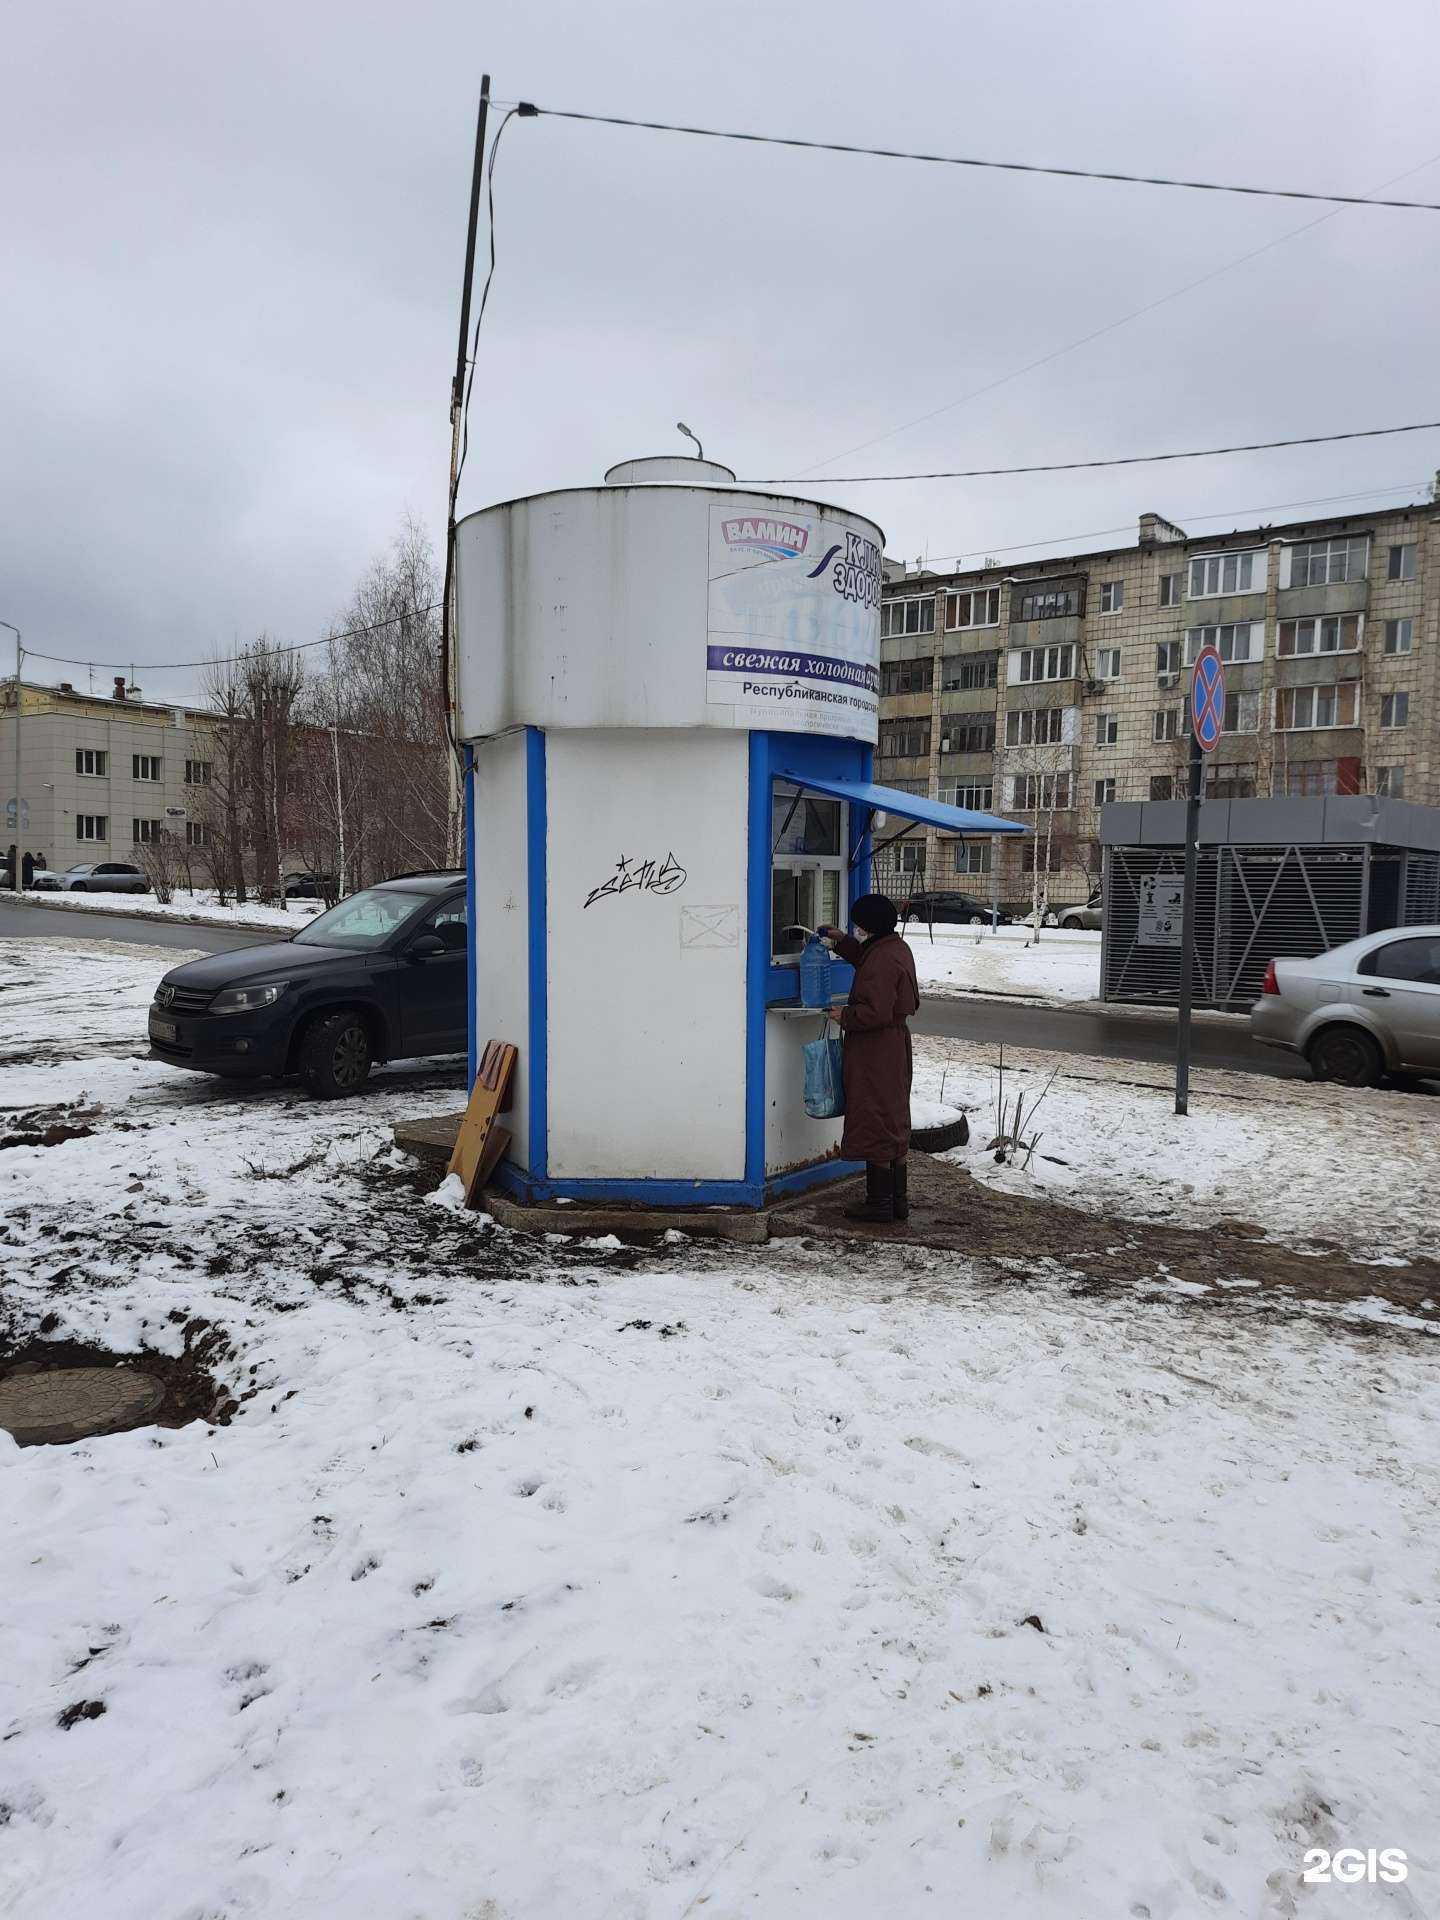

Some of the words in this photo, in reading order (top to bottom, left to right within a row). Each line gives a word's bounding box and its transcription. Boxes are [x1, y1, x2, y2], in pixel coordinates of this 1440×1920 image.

[726, 521, 805, 548] ВАМИН
[833, 563, 881, 609] ЗДОРО
[723, 652, 800, 671] свежая
[805, 659, 865, 683] холодная
[743, 682, 847, 704] Республиканская
